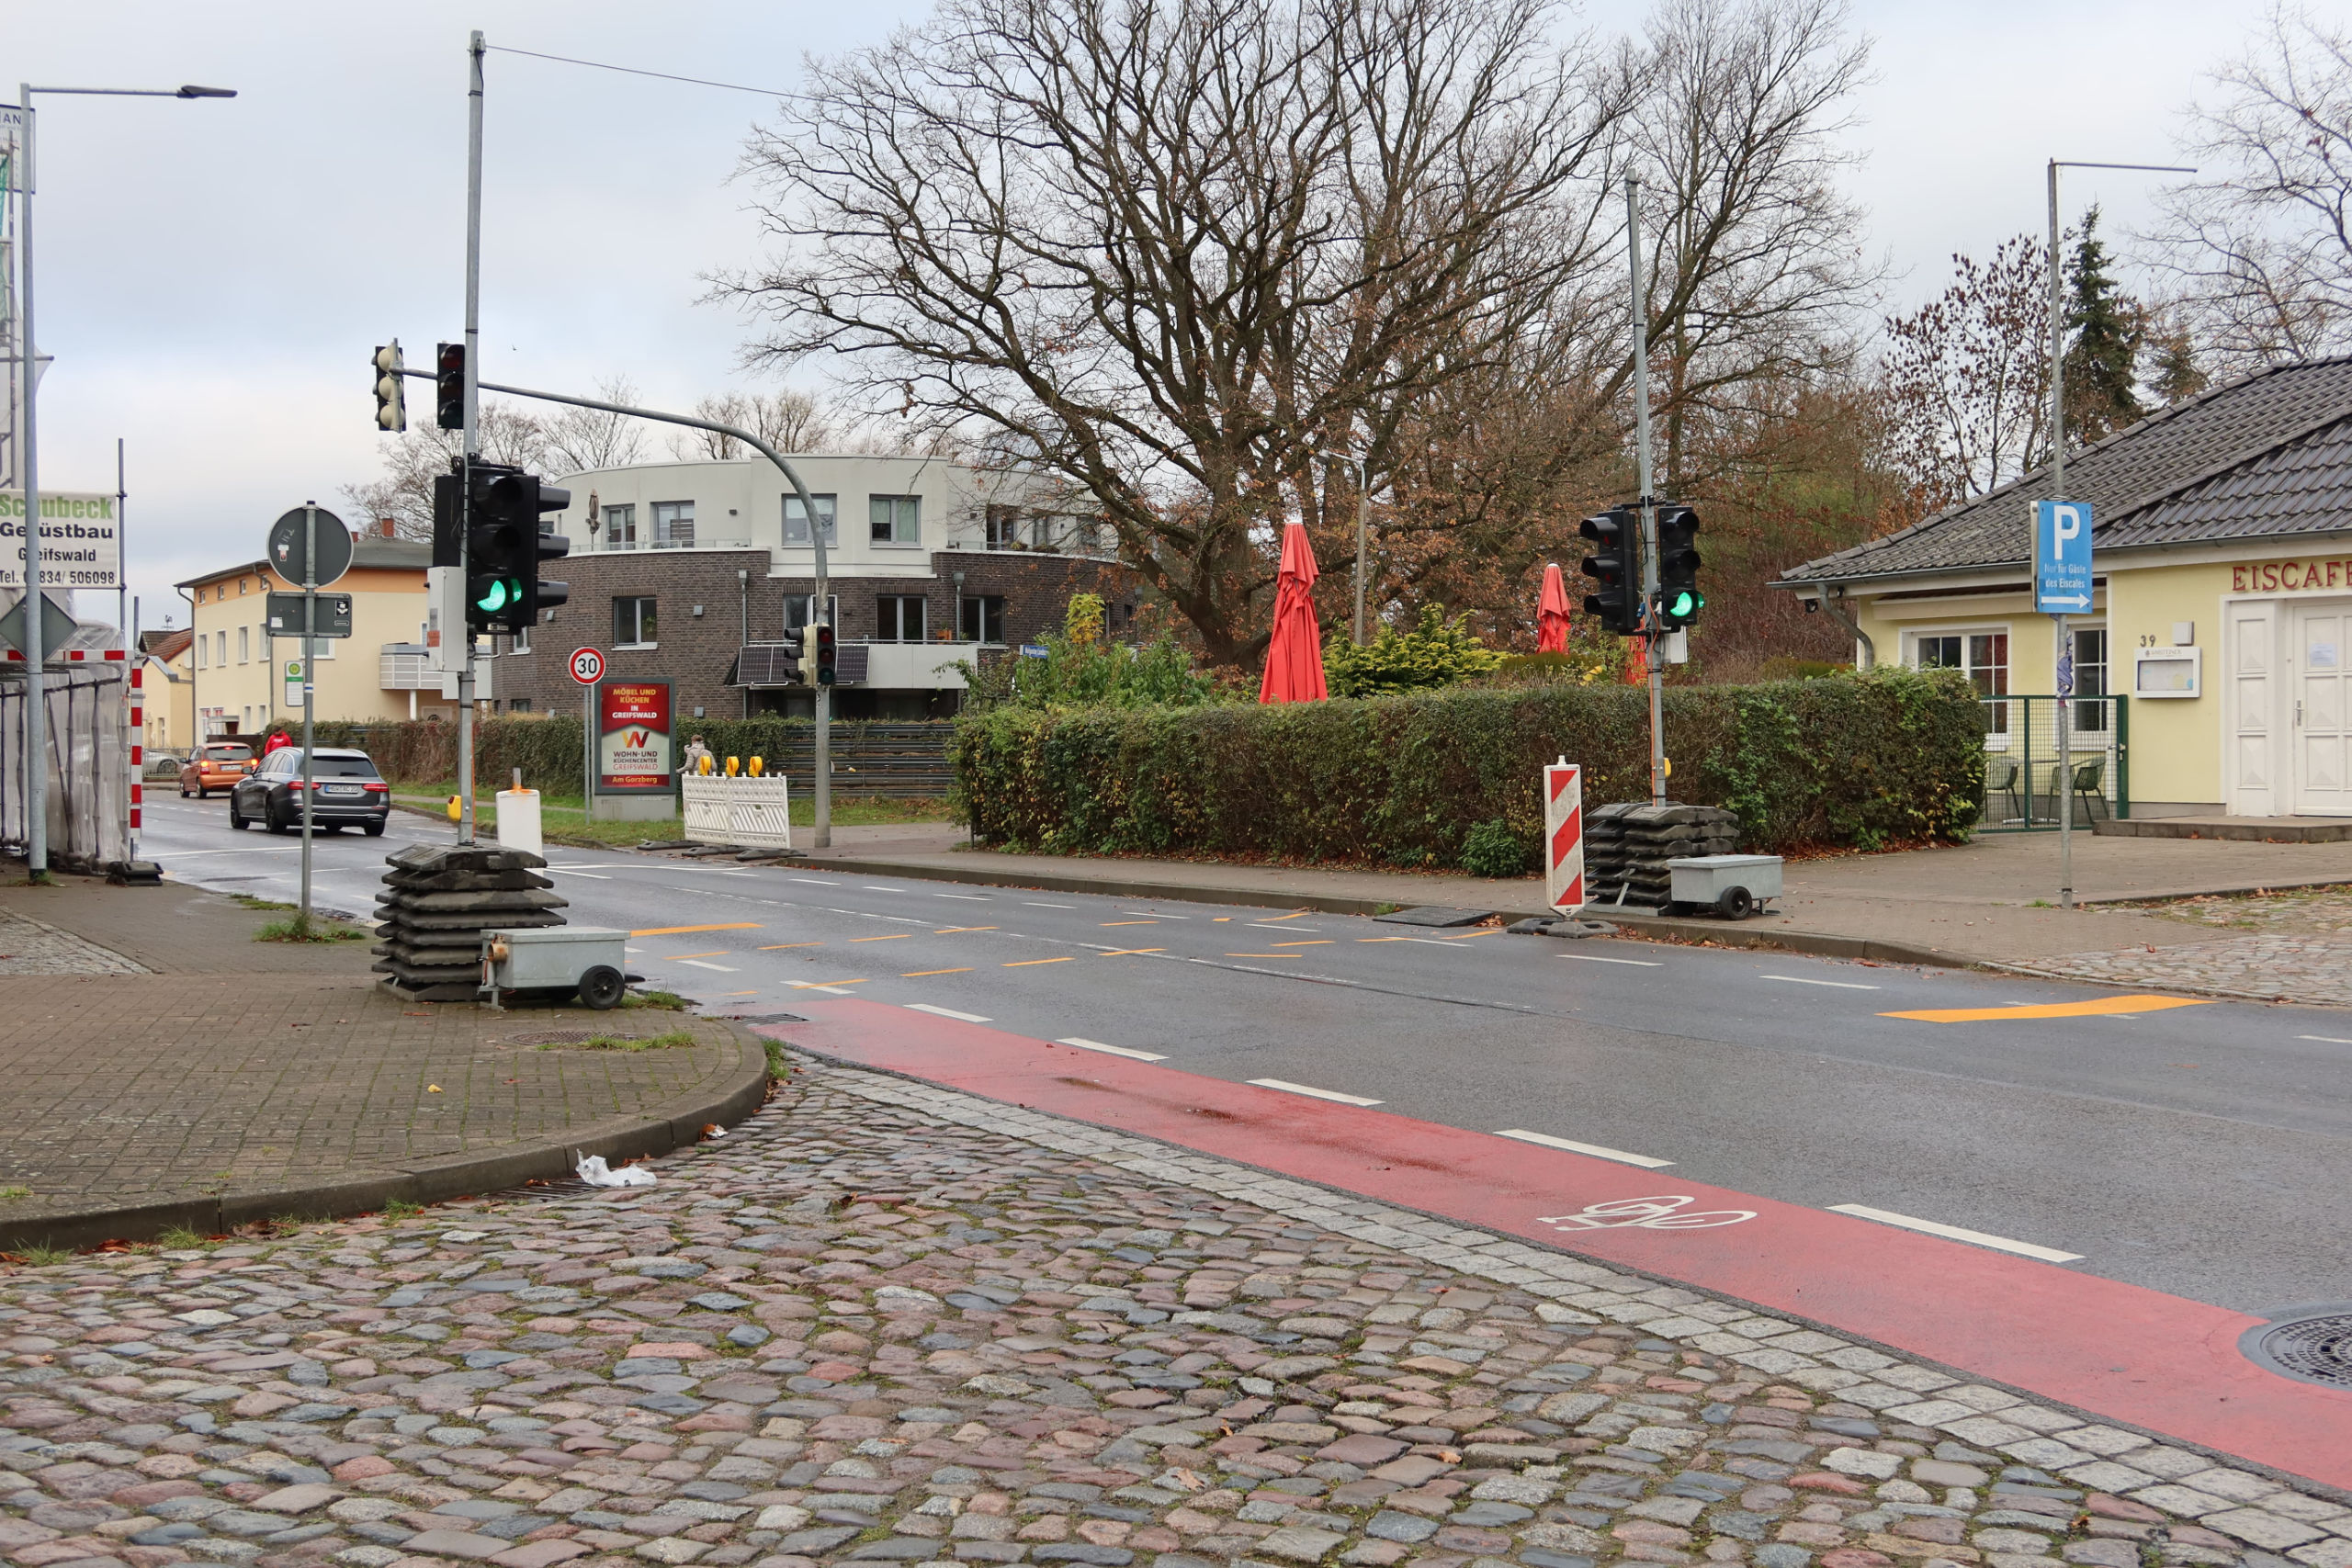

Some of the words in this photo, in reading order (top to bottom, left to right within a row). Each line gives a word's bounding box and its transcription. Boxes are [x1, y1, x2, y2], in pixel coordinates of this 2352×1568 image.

[0, 112, 22, 125] AN
[0, 493, 113, 520] Scubeck
[0, 522, 113, 539] Geüstbau
[2053, 504, 2080, 560] P
[18, 547, 96, 561] Gifswald
[0, 570, 19, 583] Tel.
[23, 570, 66, 585] 834/
[70, 570, 115, 584] 506098
[2045, 578, 2058, 588] des
[2140, 634, 2156, 648] 39
[577, 658, 597, 674] 30
[619, 695, 650, 704] KÜCHEN
